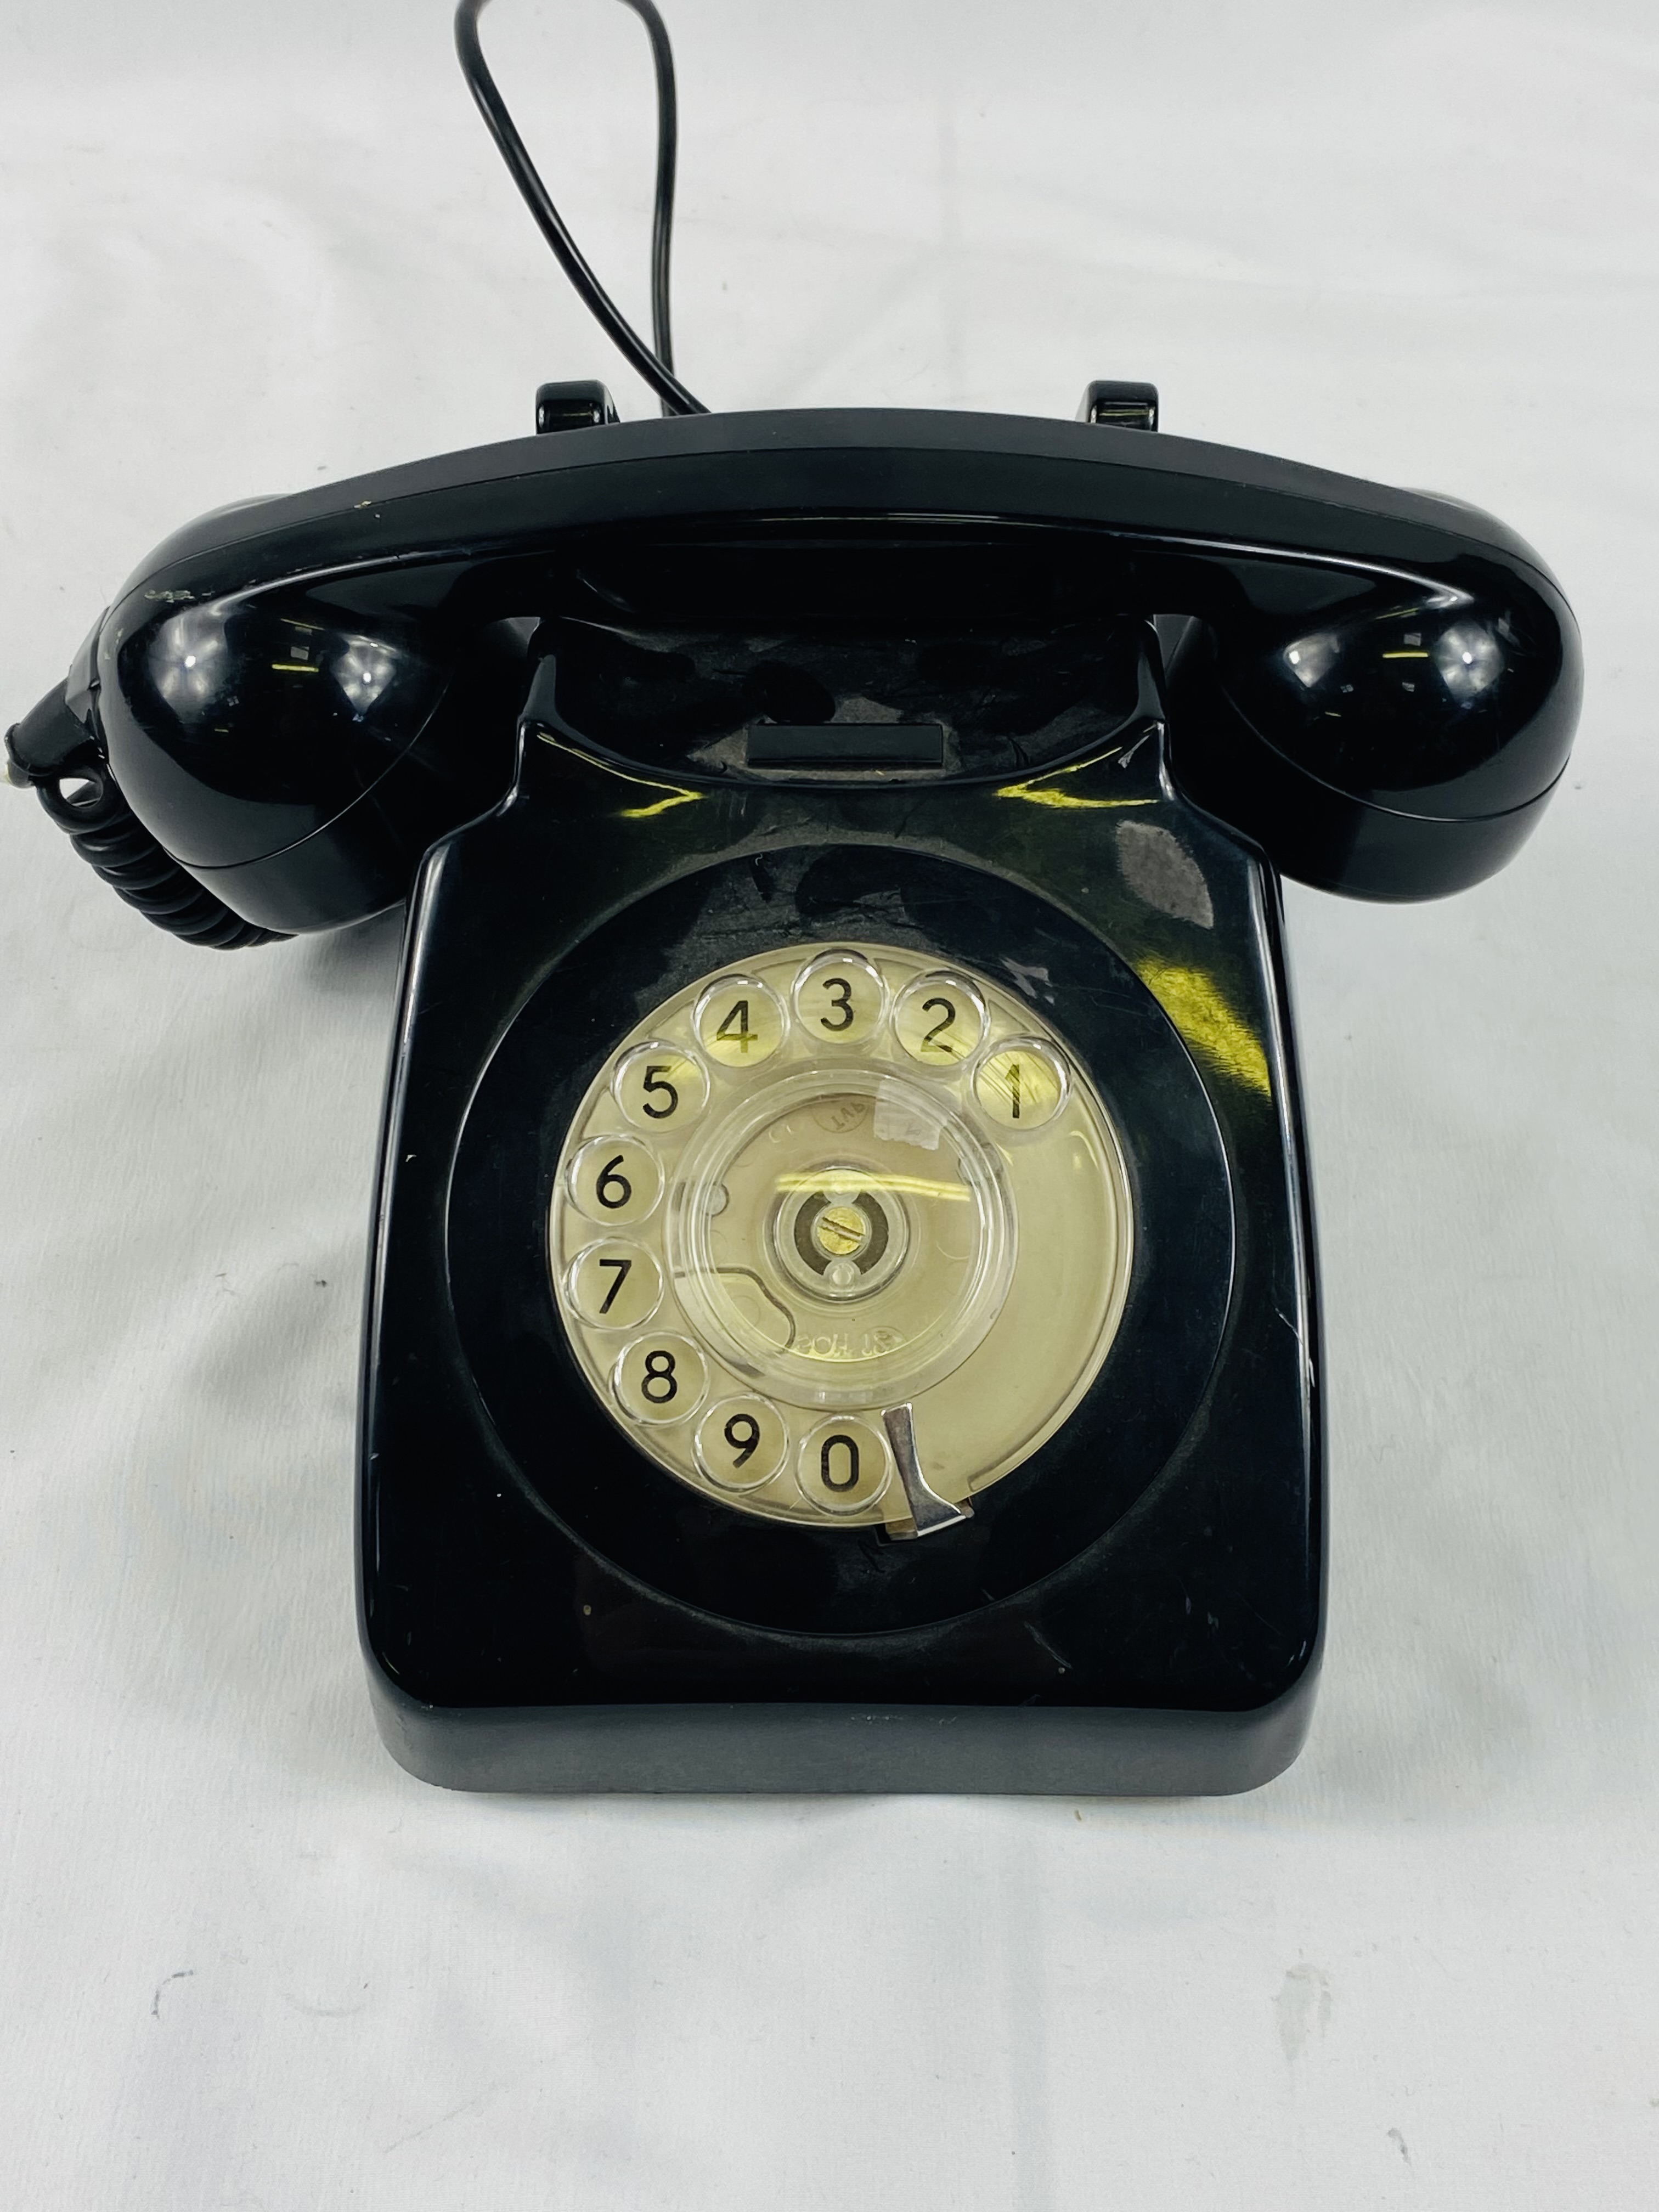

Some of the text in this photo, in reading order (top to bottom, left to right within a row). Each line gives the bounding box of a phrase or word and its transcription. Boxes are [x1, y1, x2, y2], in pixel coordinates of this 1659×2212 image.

[716, 1000, 758, 1053] 4
[821, 978, 854, 1031] 3
[921, 998, 956, 1052] 2
[642, 1065, 678, 1119] 5
[1005, 1064, 1022, 1119] 1
[596, 1155, 632, 1209] 6
[599, 1259, 631, 1313] 7
[641, 1350, 678, 1404] 8
[724, 1413, 760, 1468] 9
[821, 1435, 860, 1492] 0
